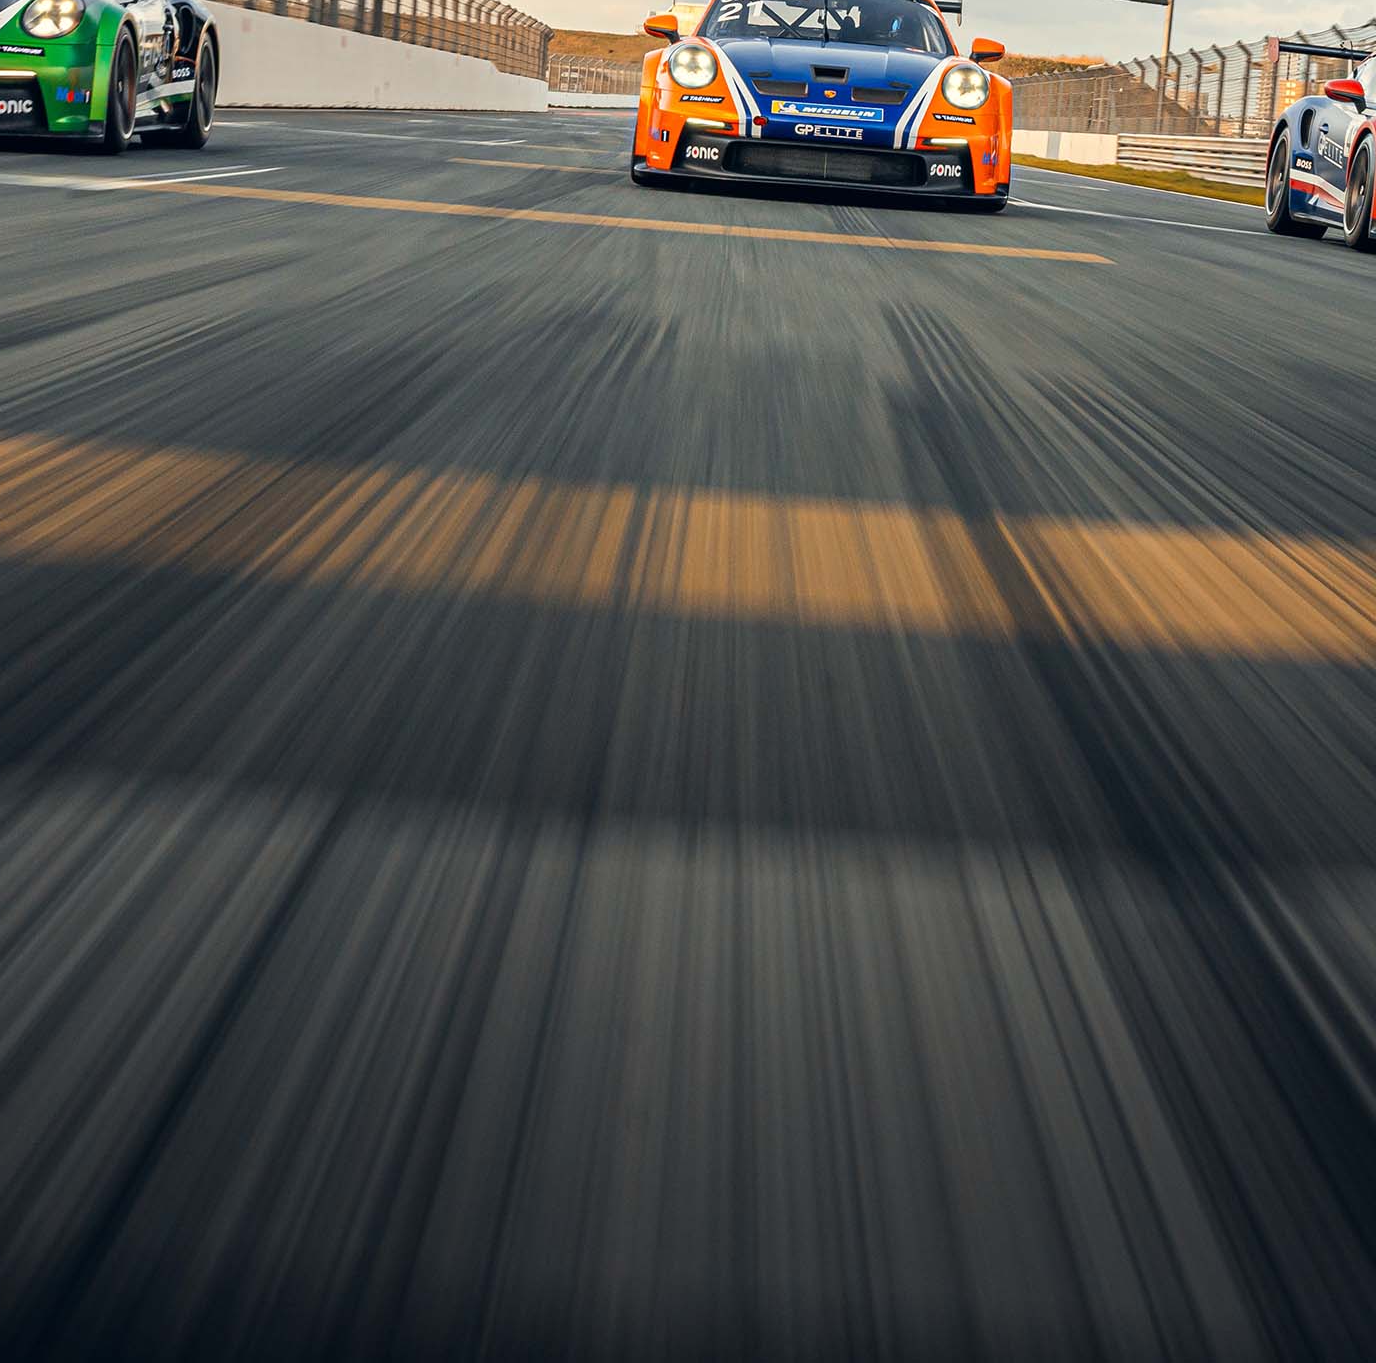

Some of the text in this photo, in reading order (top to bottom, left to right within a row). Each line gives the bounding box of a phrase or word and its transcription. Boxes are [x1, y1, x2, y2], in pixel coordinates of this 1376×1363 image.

[717, 1, 765, 23] 21
[801, 106, 876, 118] MICHELIN
[1295, 158, 1313, 171] BOSS
